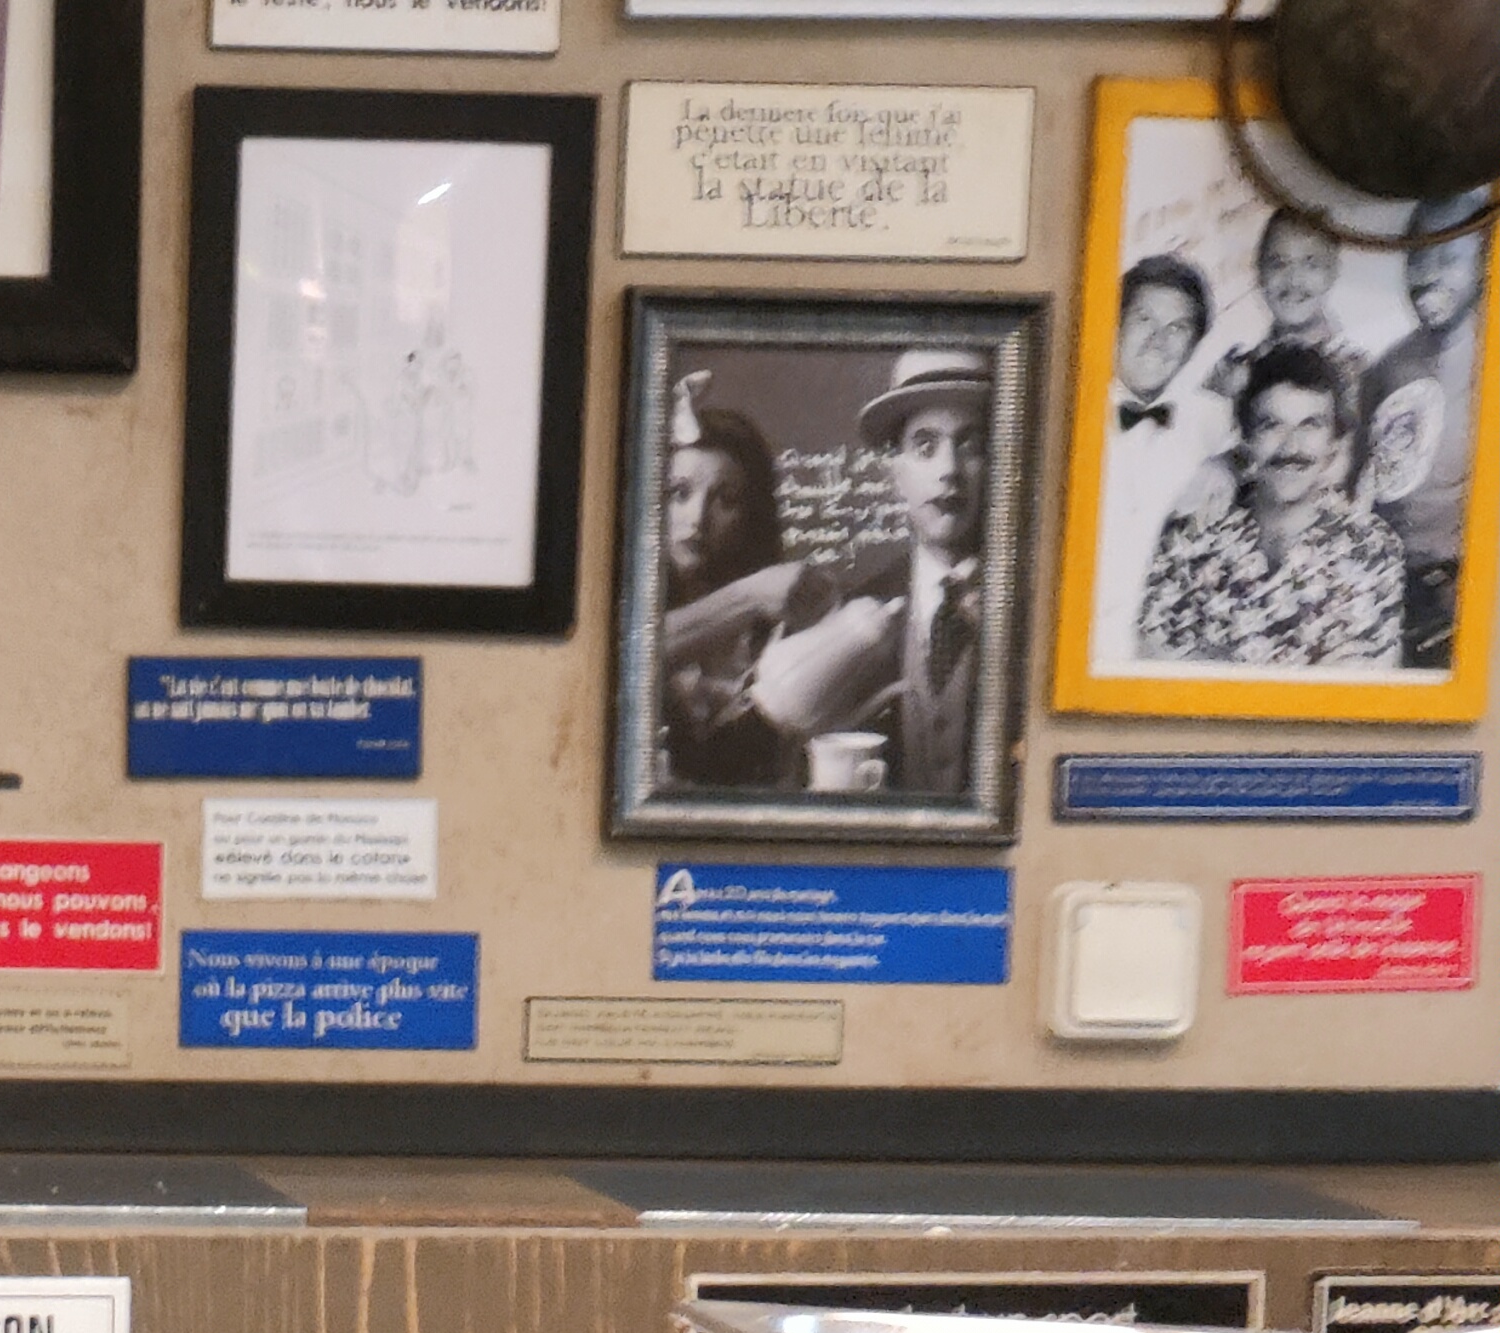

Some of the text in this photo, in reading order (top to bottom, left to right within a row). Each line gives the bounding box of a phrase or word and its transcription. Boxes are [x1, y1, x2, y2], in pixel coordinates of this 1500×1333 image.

[878, 105, 921, 134] que
[794, 126, 846, 145] une
[791, 152, 827, 172] en
[692, 164, 950, 205] la statue de la
[18, 916, 43, 939] le
[186, 947, 241, 968] Nous
[242, 952, 309, 970] vivons
[326, 955, 366, 971] une
[225, 975, 247, 998] la
[250, 981, 307, 1004] pizza
[310, 979, 376, 1000] arrive
[375, 976, 425, 1006] plus
[426, 980, 471, 1000] vite
[218, 1000, 404, 1039] que la police
